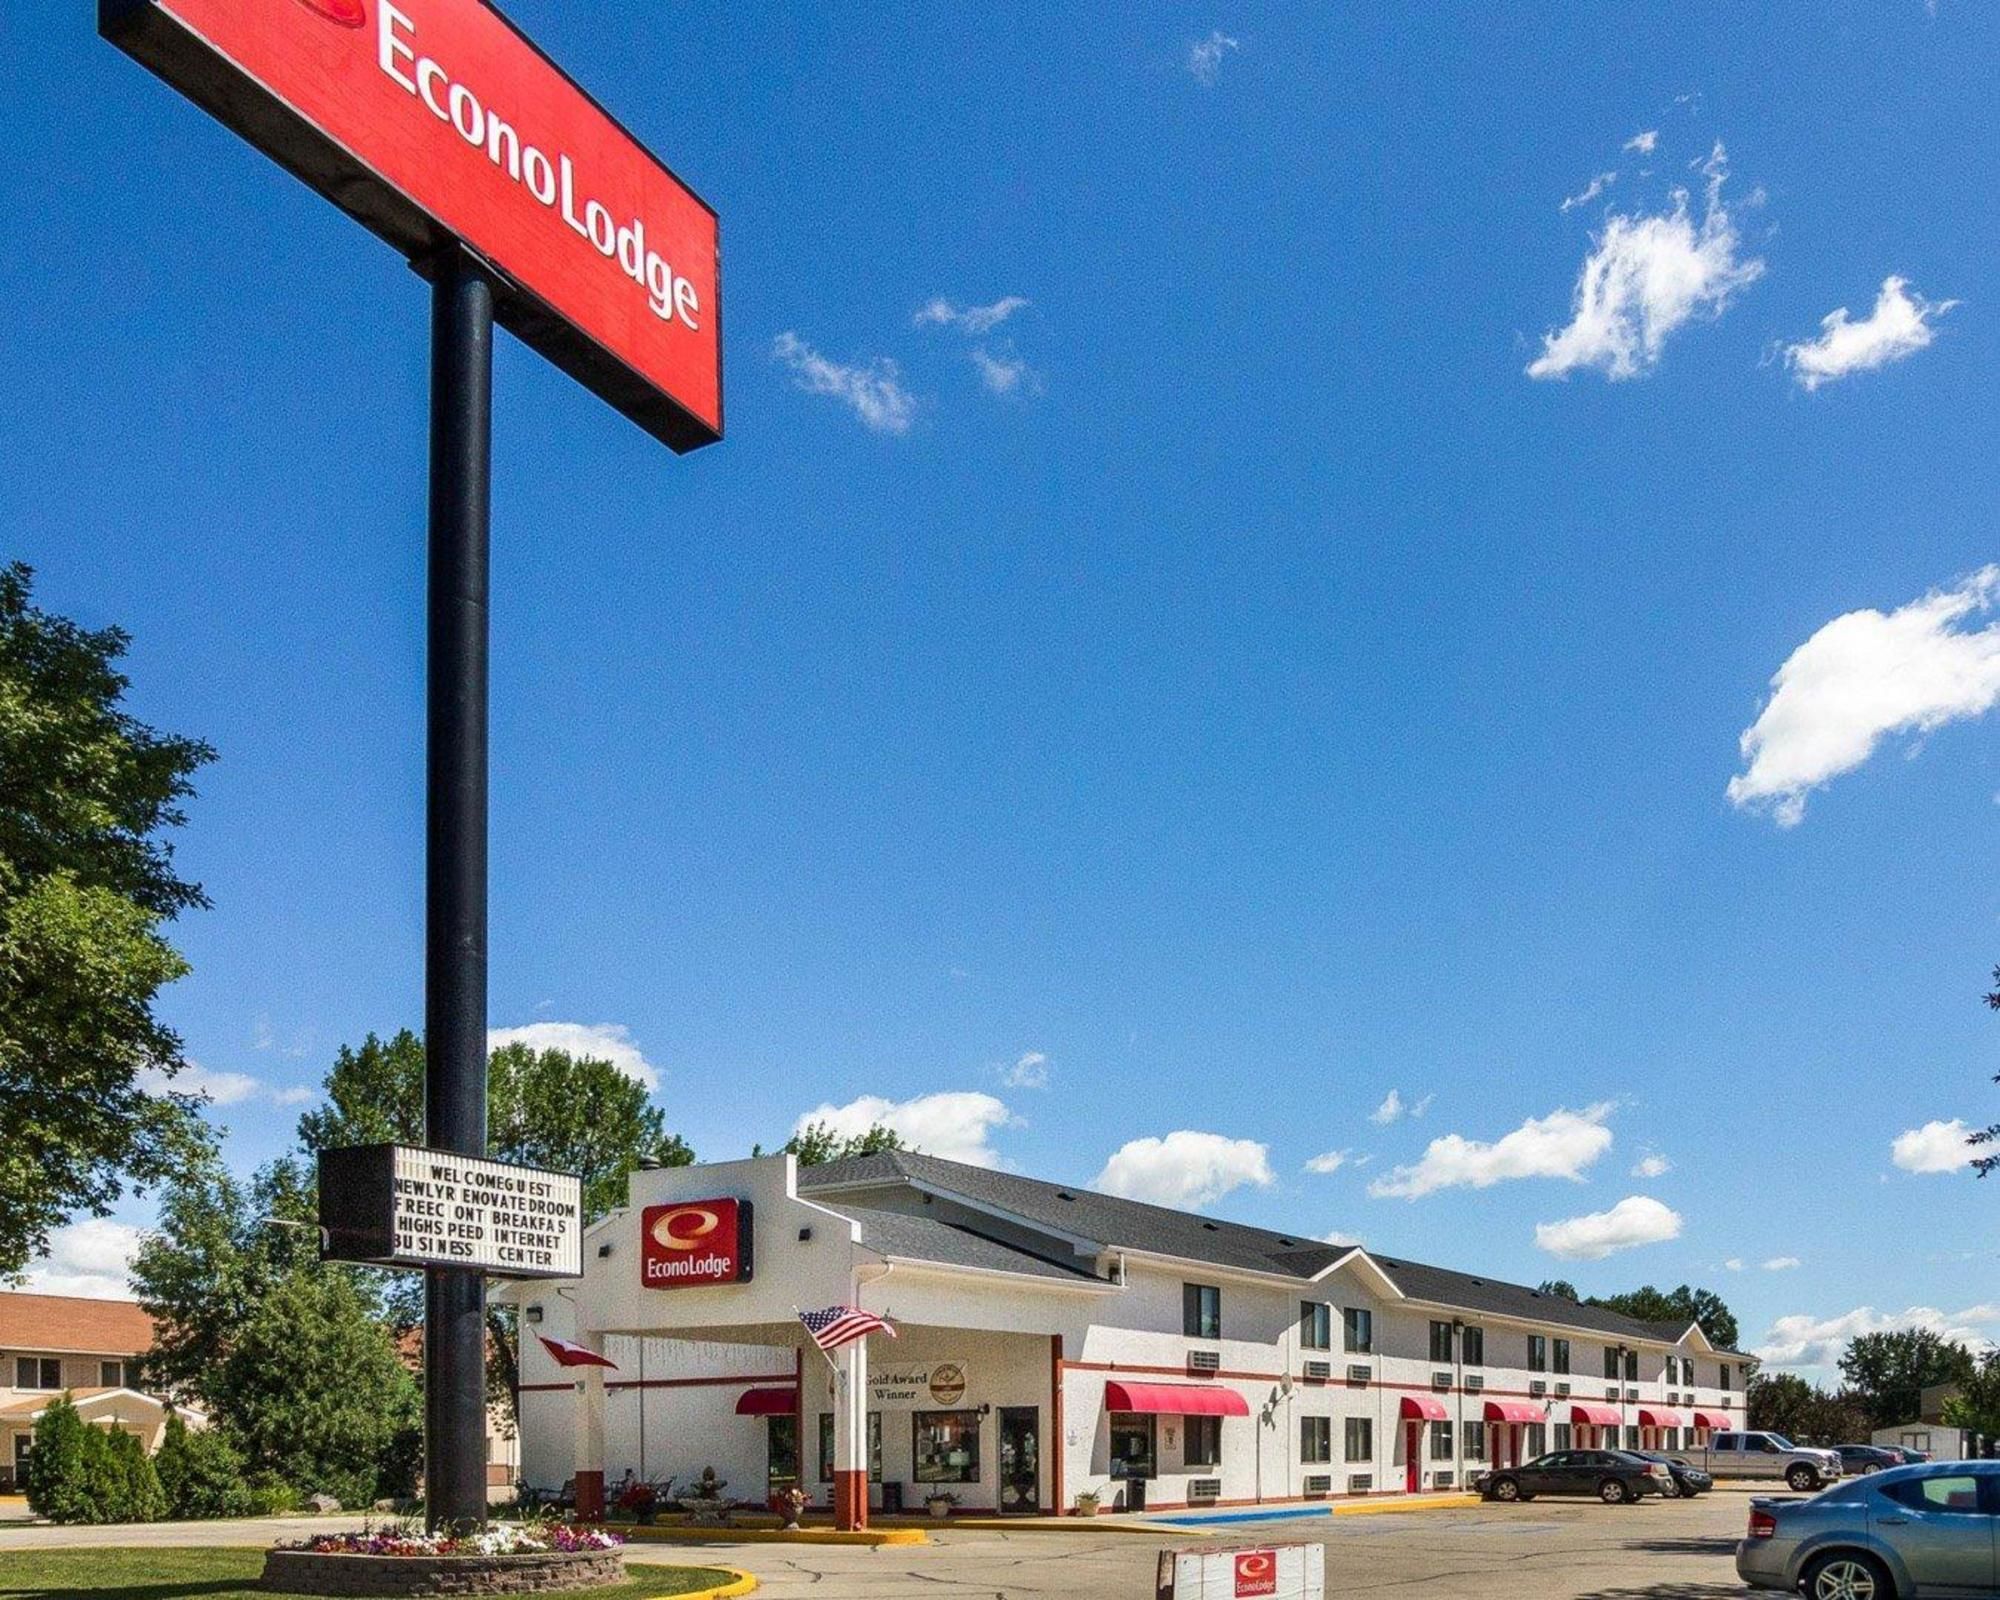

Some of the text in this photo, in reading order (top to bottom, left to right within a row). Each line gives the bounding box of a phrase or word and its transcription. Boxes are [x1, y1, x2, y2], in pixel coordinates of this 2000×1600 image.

[378, 0, 700, 331] EconoLodge
[494, 1228, 561, 1249] INTERNET
[498, 1246, 552, 1266] CENTER
[647, 1253, 731, 1278] EconoLodge
[891, 1372, 928, 1386] Award
[875, 1388, 917, 1400] Winner
